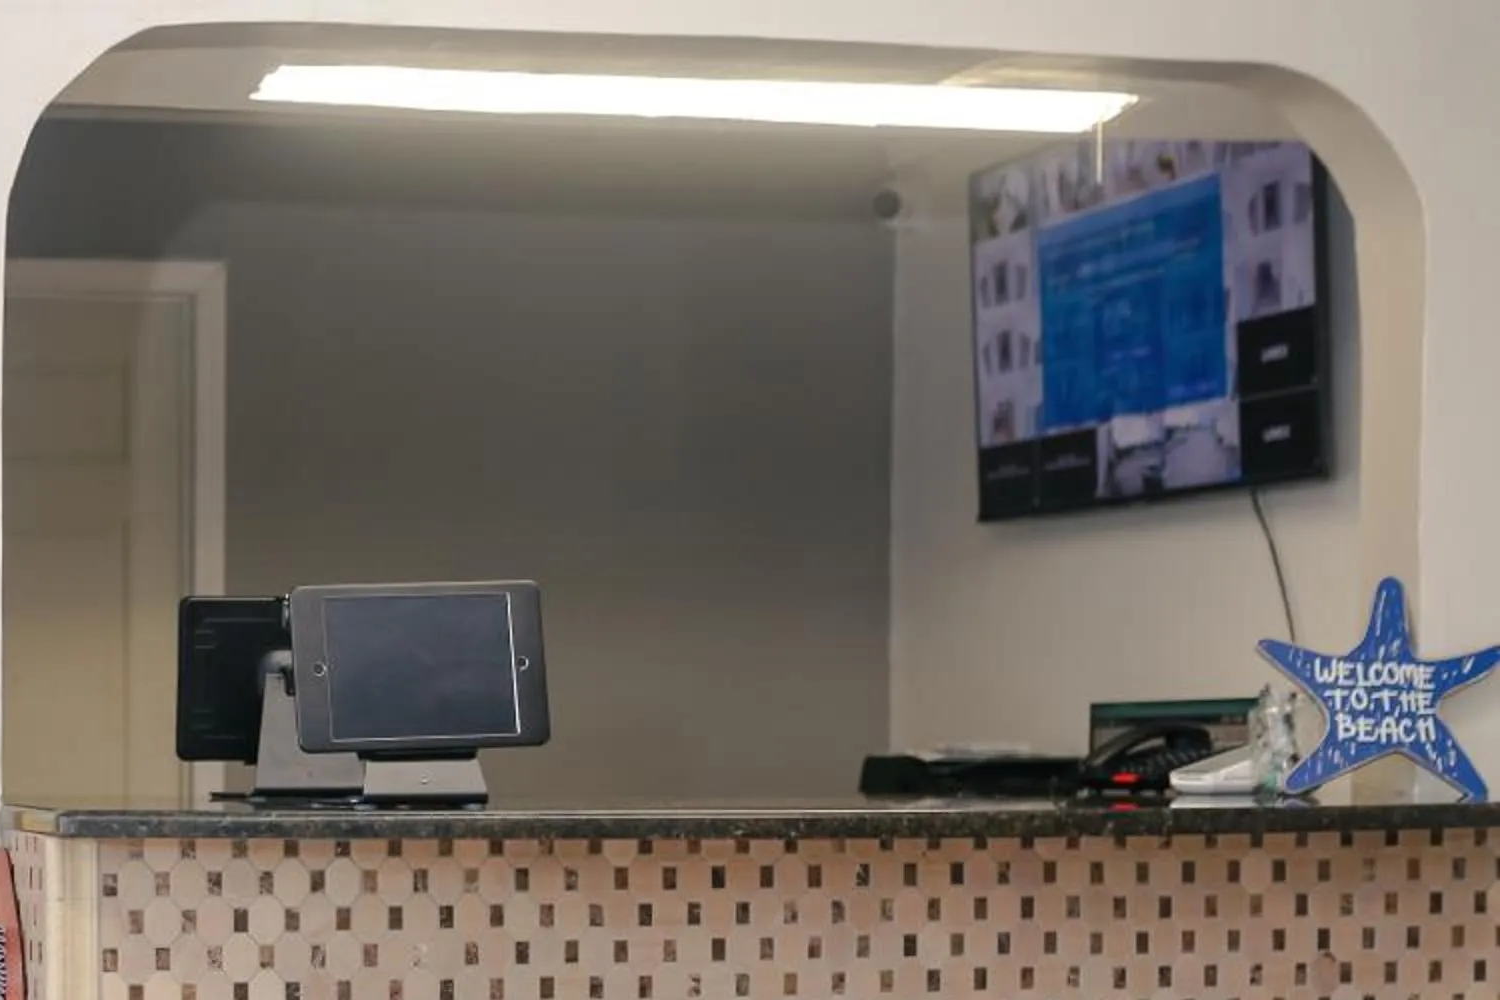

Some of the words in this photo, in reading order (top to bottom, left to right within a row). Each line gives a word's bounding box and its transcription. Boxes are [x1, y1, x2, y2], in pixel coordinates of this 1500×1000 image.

[1314, 656, 1436, 689] WELCOME
[1324, 687, 1368, 711] TO
[1370, 690, 1437, 715] THE
[1335, 712, 1436, 744] BEACH
